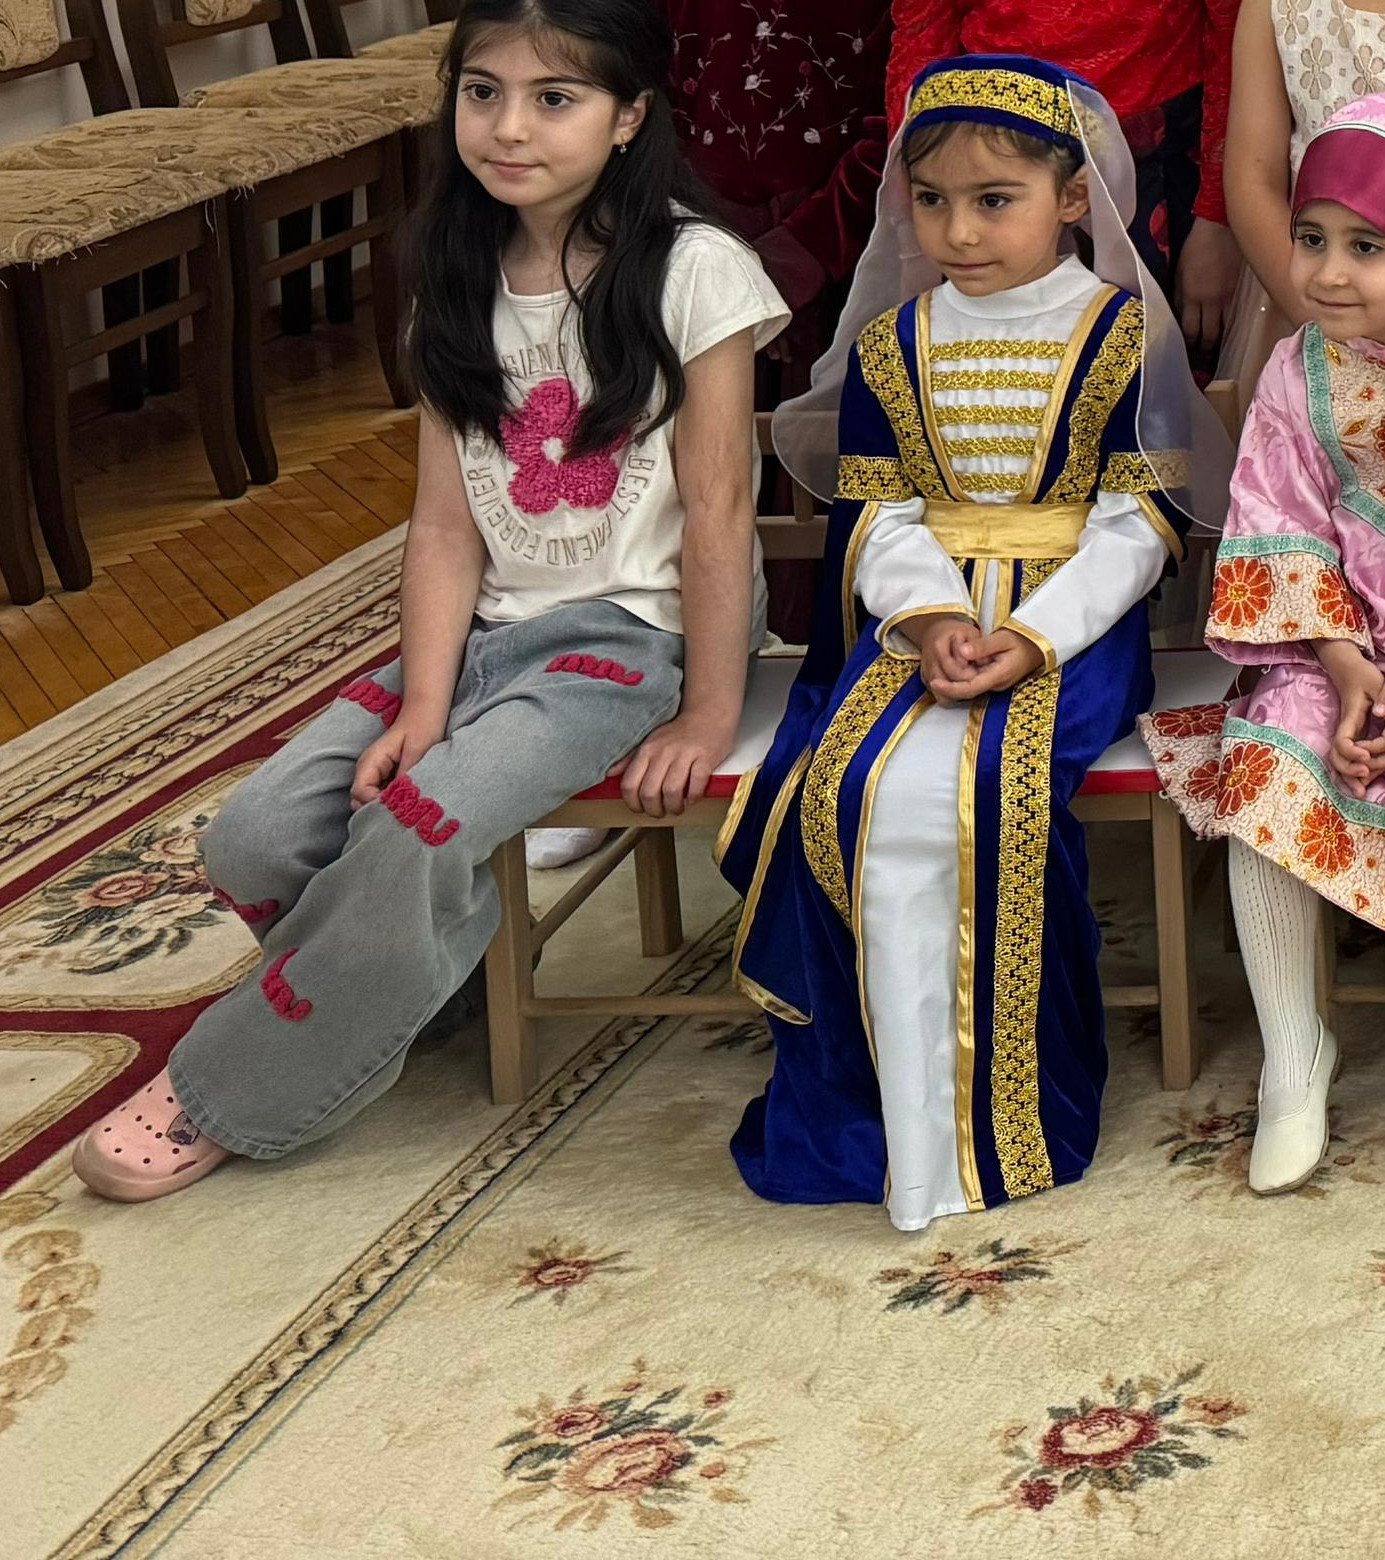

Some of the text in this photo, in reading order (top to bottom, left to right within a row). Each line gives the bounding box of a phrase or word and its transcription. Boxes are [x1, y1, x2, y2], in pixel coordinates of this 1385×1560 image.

[501, 342, 567, 380] RIEND
[467, 454, 656, 566] BEST FRIEND FOREVER
